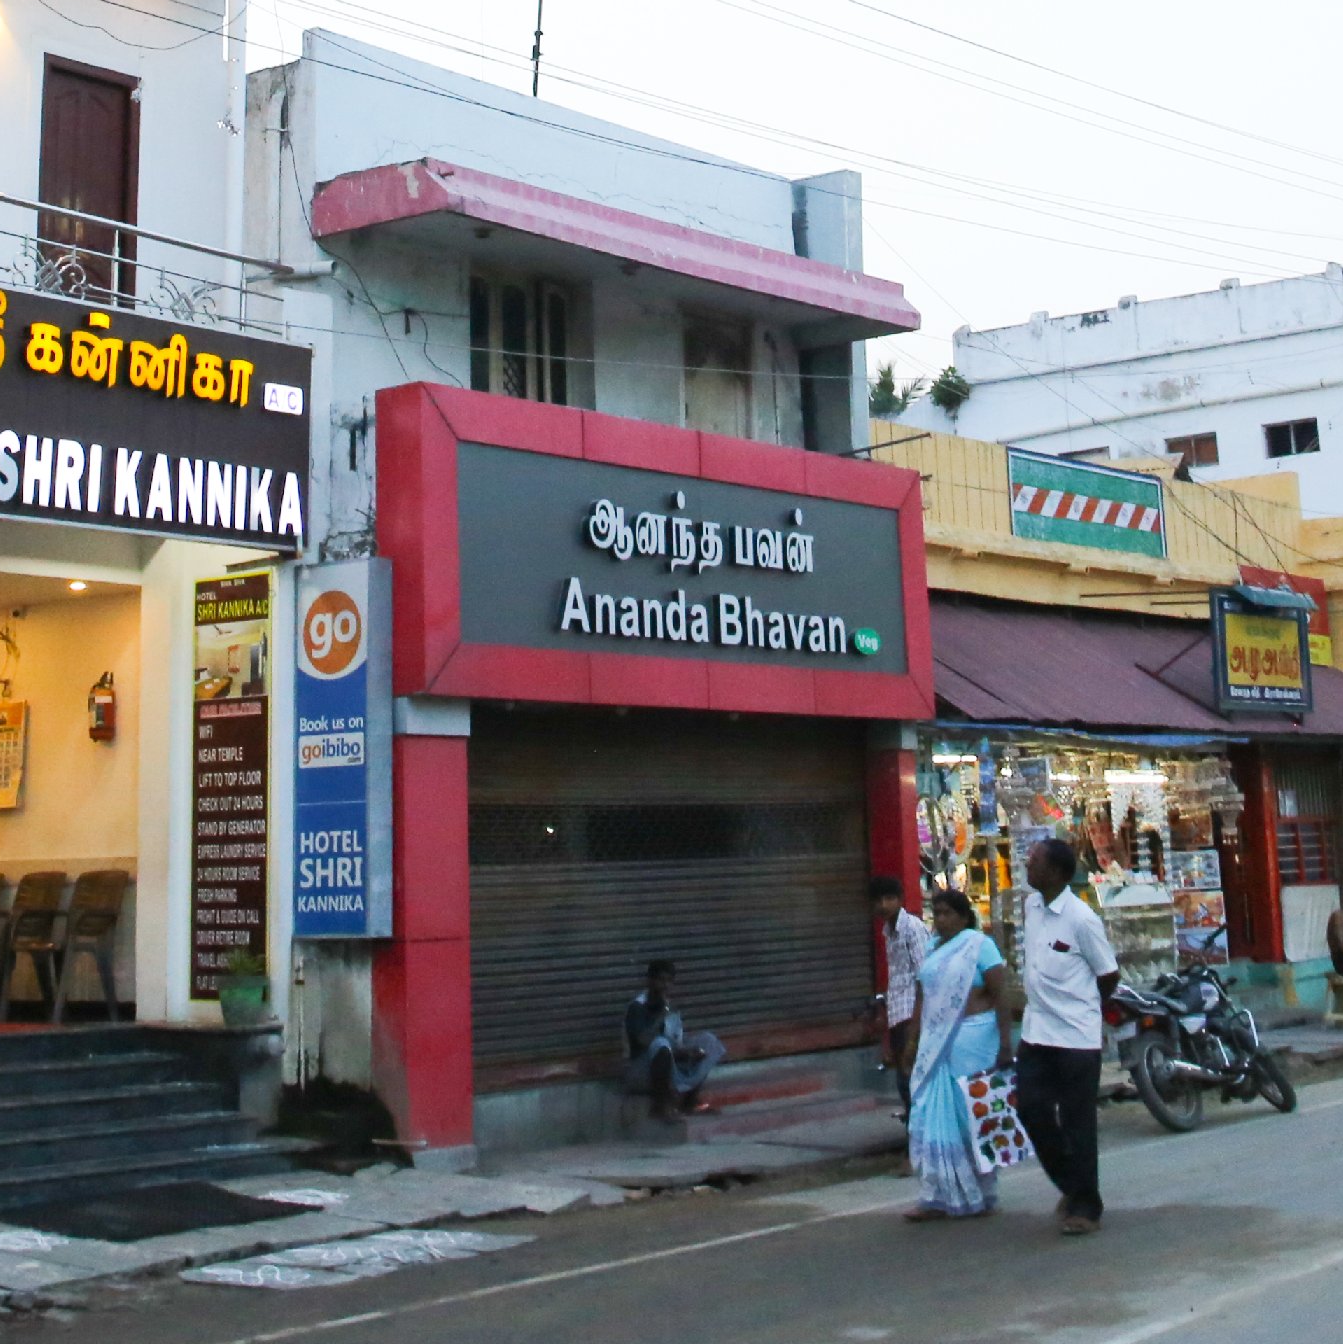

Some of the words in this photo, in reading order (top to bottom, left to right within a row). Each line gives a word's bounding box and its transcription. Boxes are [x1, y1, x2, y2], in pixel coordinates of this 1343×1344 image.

[25, 312, 254, 409] கன்னிகா
[113, 446, 304, 537] KANNIKA
[589, 490, 723, 575] ஆனந்த
[734, 507, 815, 574] பவன்
[197, 603, 217, 622] SHRI
[218, 599, 255, 620] KANNIKA
[560, 576, 710, 645] Ananda
[719, 593, 847, 655] Bhavan
[309, 609, 357, 659] go
[299, 715, 329, 733] Book
[332, 717, 345, 730] us
[348, 715, 364, 729] on
[198, 747, 217, 763] NEAR
[218, 746, 243, 762] TEMPLE
[301, 738, 361, 765] goibibo
[214, 772, 223, 787] TO
[224, 771, 238, 786] TOP
[238, 770, 262, 785] FLOOR
[198, 797, 218, 812] CHECK
[219, 796, 233, 811] OUT
[241, 795, 264, 810] HOURS
[197, 821, 218, 836] STAND
[218, 820, 227, 836] BY
[228, 819, 266, 835] GENERATOR
[299, 830, 363, 854] HOTEL
[299, 856, 364, 889] SHRI
[297, 895, 364, 913] KANNIKA
